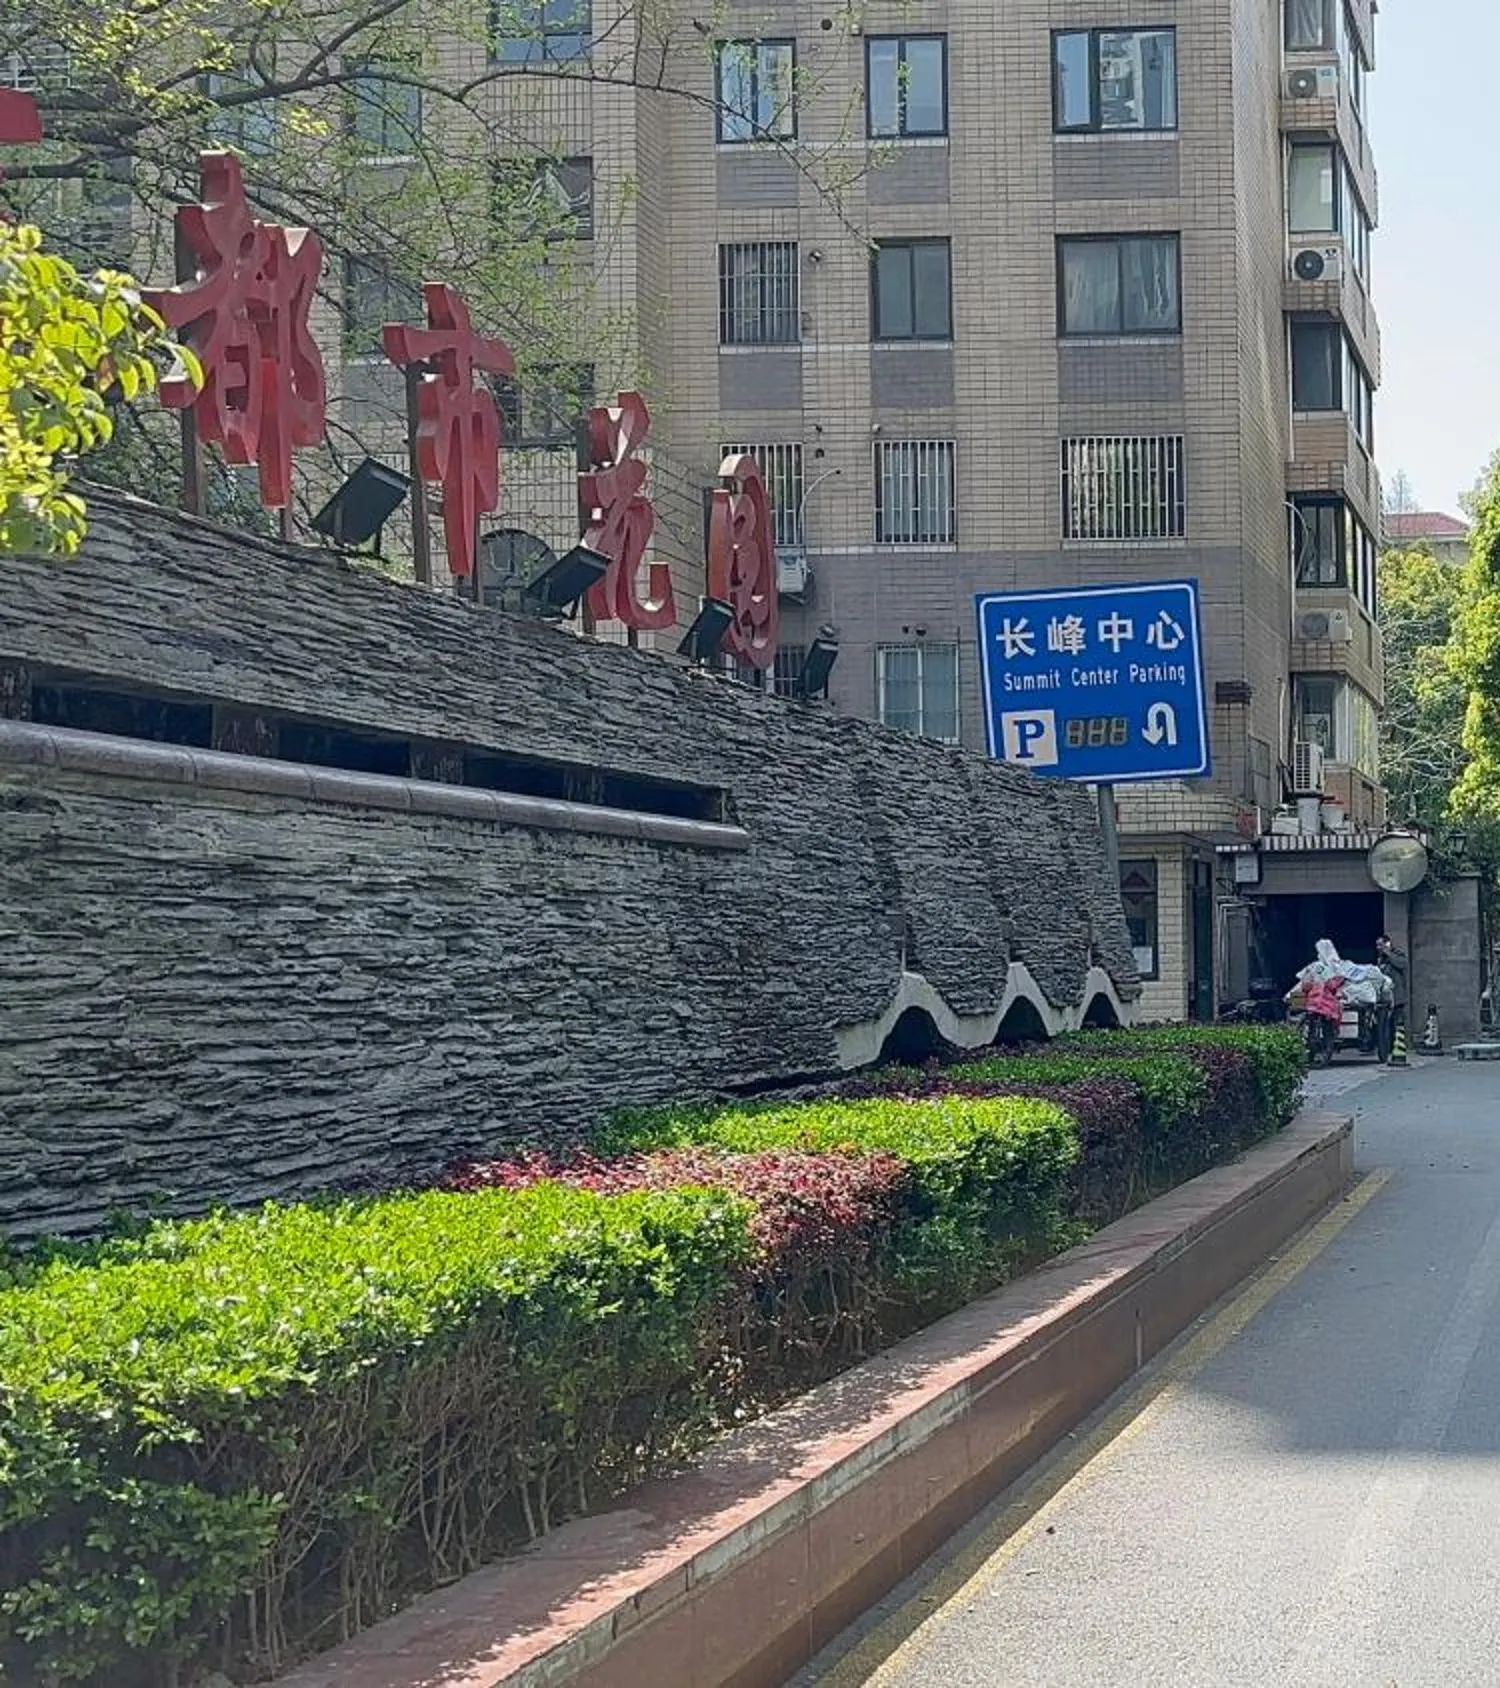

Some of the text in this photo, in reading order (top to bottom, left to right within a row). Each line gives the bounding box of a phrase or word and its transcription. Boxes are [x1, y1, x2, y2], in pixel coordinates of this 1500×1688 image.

[995, 609, 1185, 660] 长峰中心
[1004, 661, 1185, 692] Summit Center Parking
[1013, 718, 1045, 758] P
